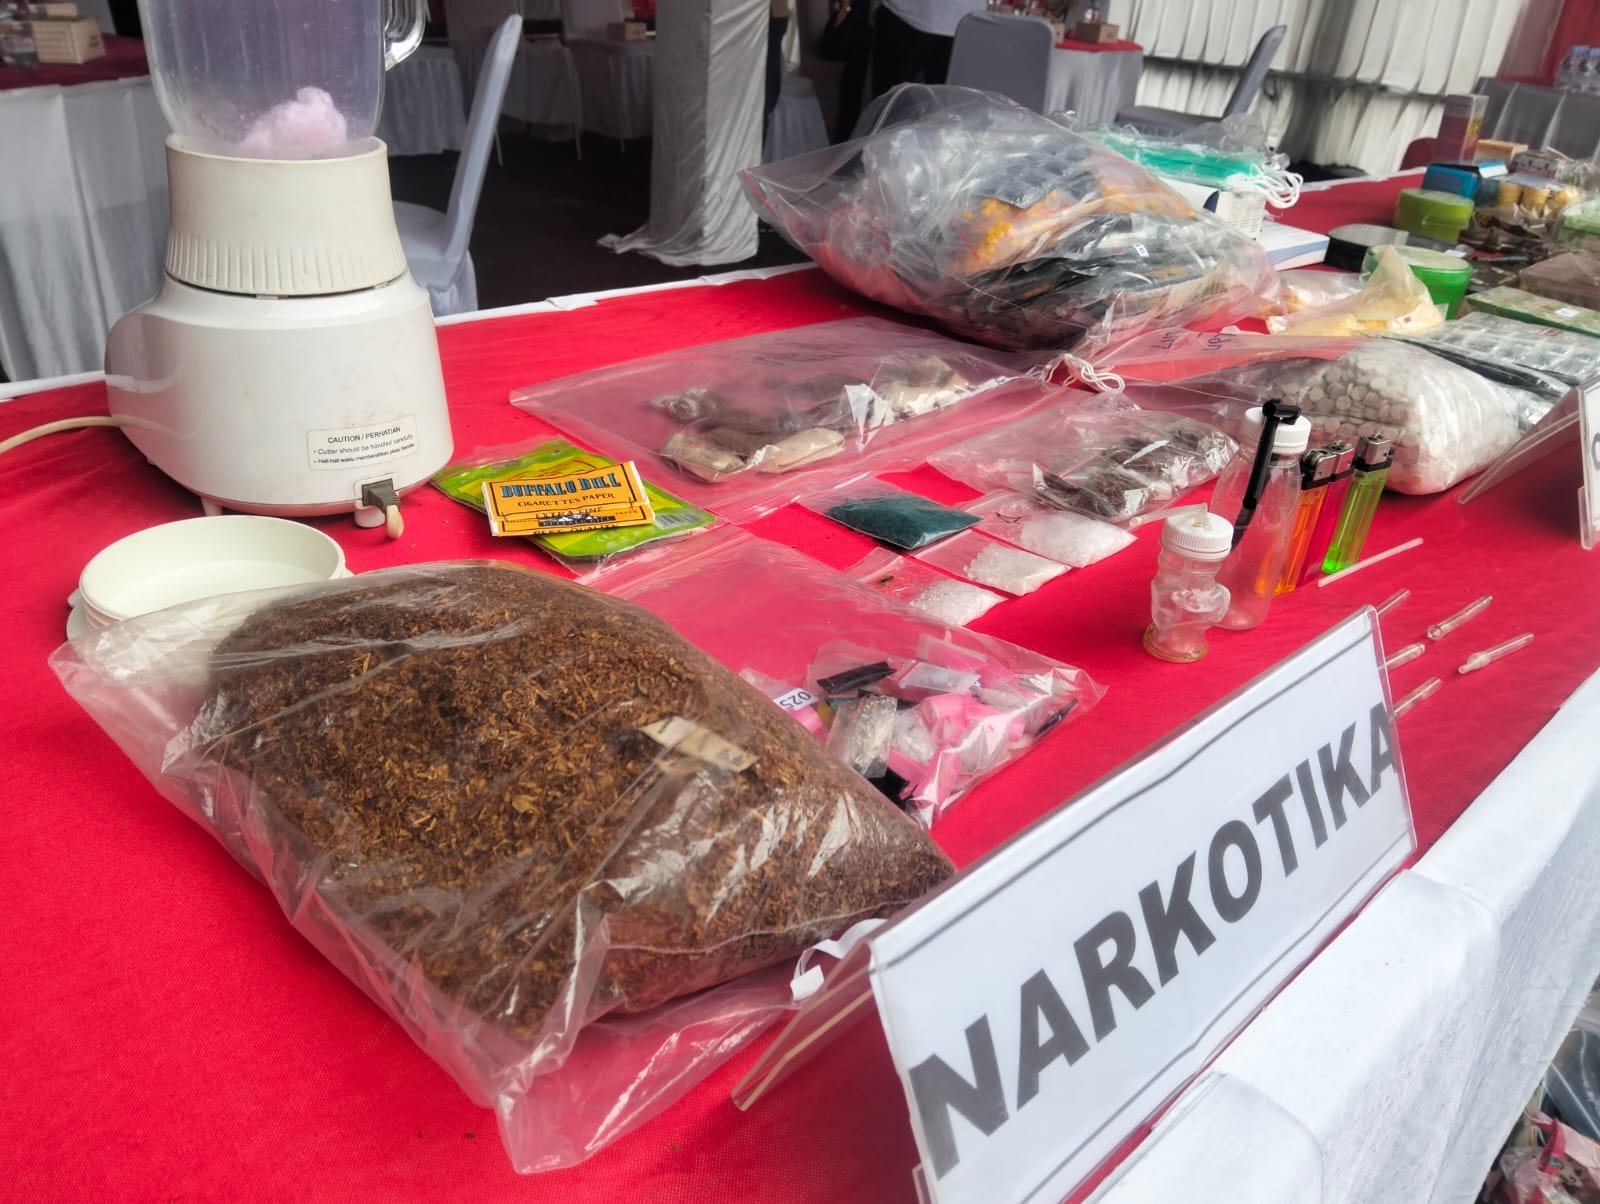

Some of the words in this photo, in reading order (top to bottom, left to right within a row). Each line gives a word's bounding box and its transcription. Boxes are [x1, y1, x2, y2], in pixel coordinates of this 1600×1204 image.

[328, 435, 361, 443] CAUTION
[366, 426, 401, 439] PERHATIAN
[501, 480, 577, 498] BUFFALO
[578, 472, 622, 491] BILL
[517, 498, 581, 507] CIGARETTES
[582, 492, 616, 501] PAPER
[779, 691, 811, 708] 025
[908, 701, 1399, 1181] NARKOTIKA
